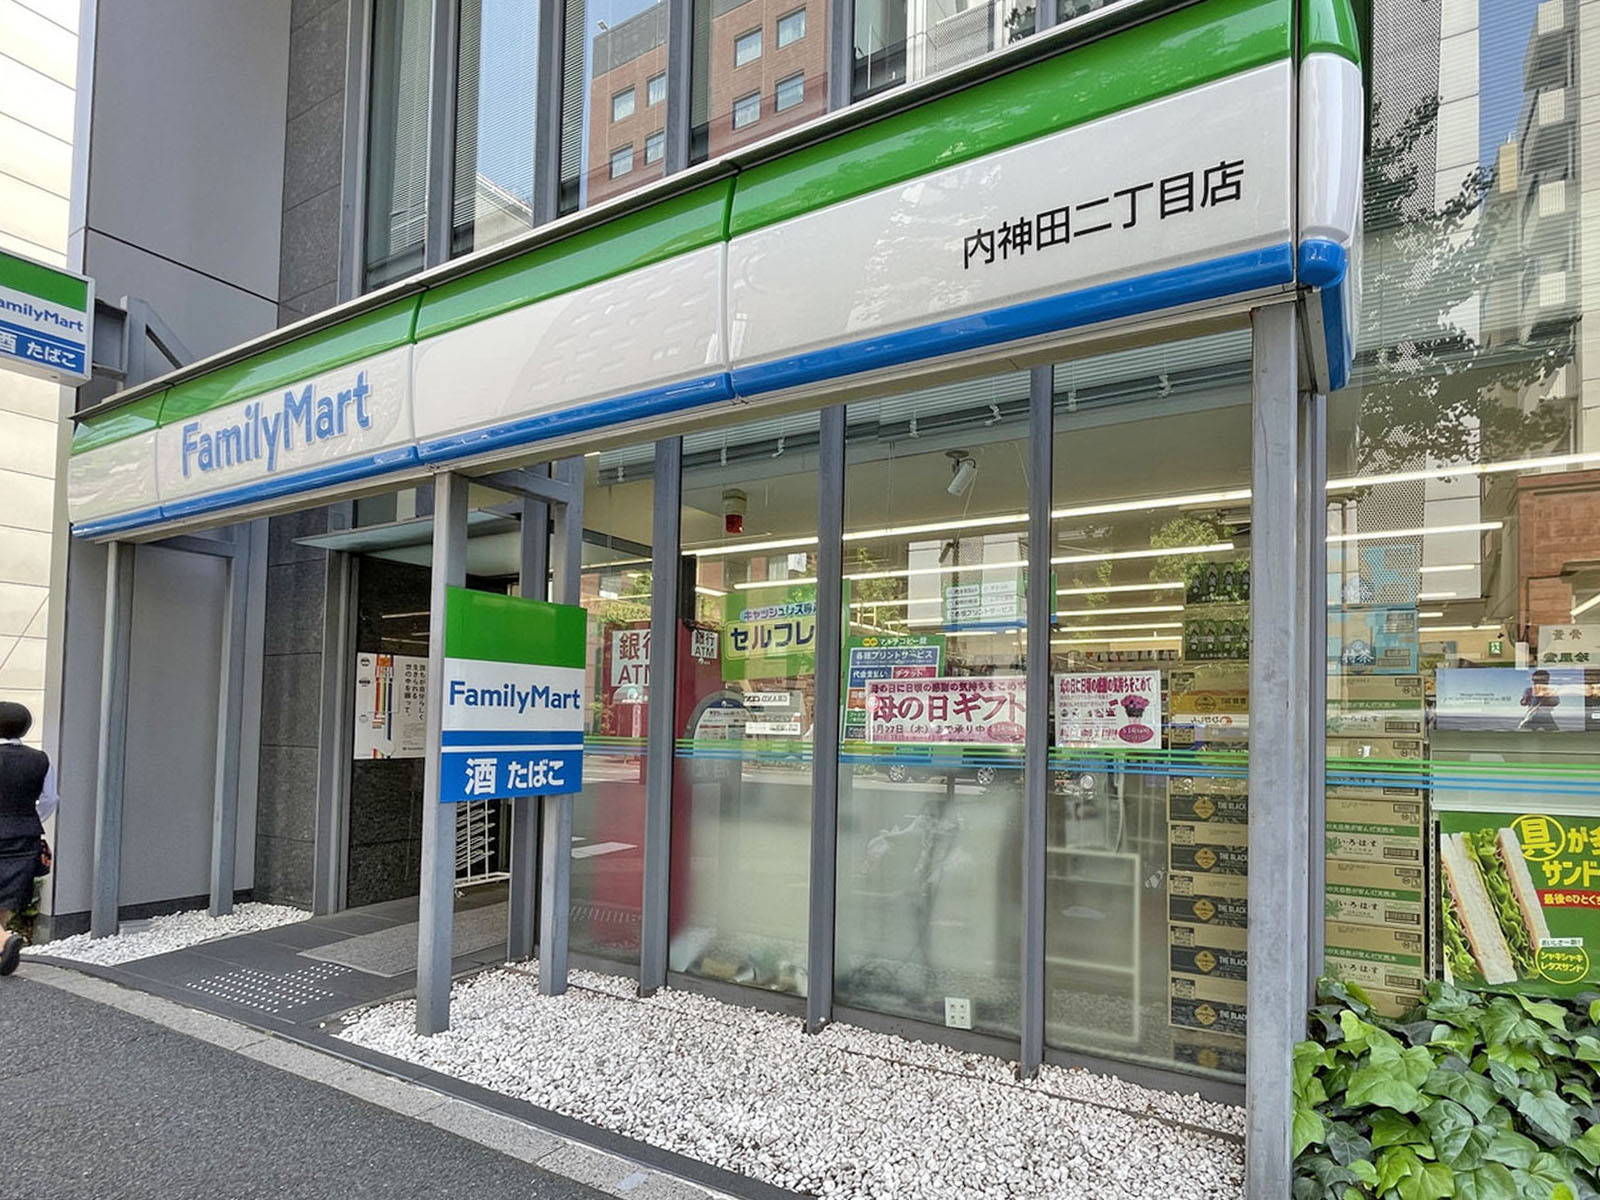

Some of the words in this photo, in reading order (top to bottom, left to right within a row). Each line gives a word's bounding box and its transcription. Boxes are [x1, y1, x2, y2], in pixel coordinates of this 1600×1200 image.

[964, 160, 1244, 269] 内神田二丁目店
[26, 341, 77, 368] たばこ
[181, 370, 373, 479] FamilyMart
[695, 631, 715, 646] 銀行
[695, 646, 715, 657] ATM
[449, 680, 581, 714] FamilyMart
[873, 692, 1026, 724] 母の日ギフト
[464, 757, 498, 796] 酒
[507, 759, 565, 790] たばこ
[1219, 852, 1229, 861] THE
[1218, 904, 1228, 912] THE
[1219, 956, 1229, 964] THE
